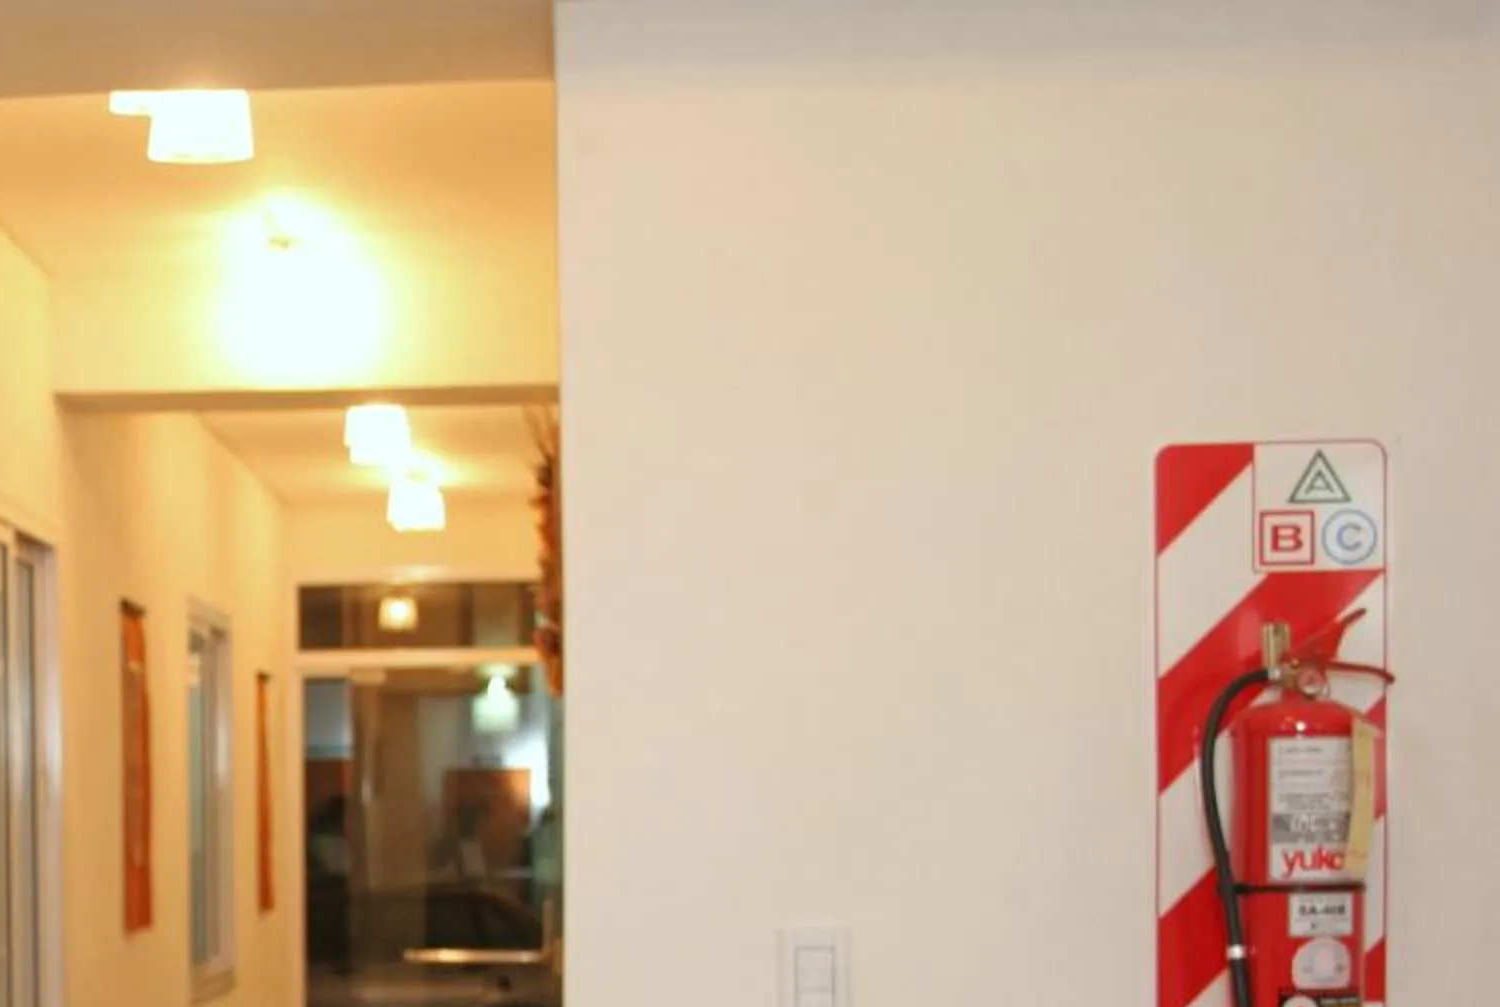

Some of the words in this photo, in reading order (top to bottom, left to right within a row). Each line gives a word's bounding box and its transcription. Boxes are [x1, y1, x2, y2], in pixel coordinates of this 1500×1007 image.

[1304, 469, 1336, 495] A
[1270, 524, 1303, 552] B
[1336, 522, 1362, 552] C
